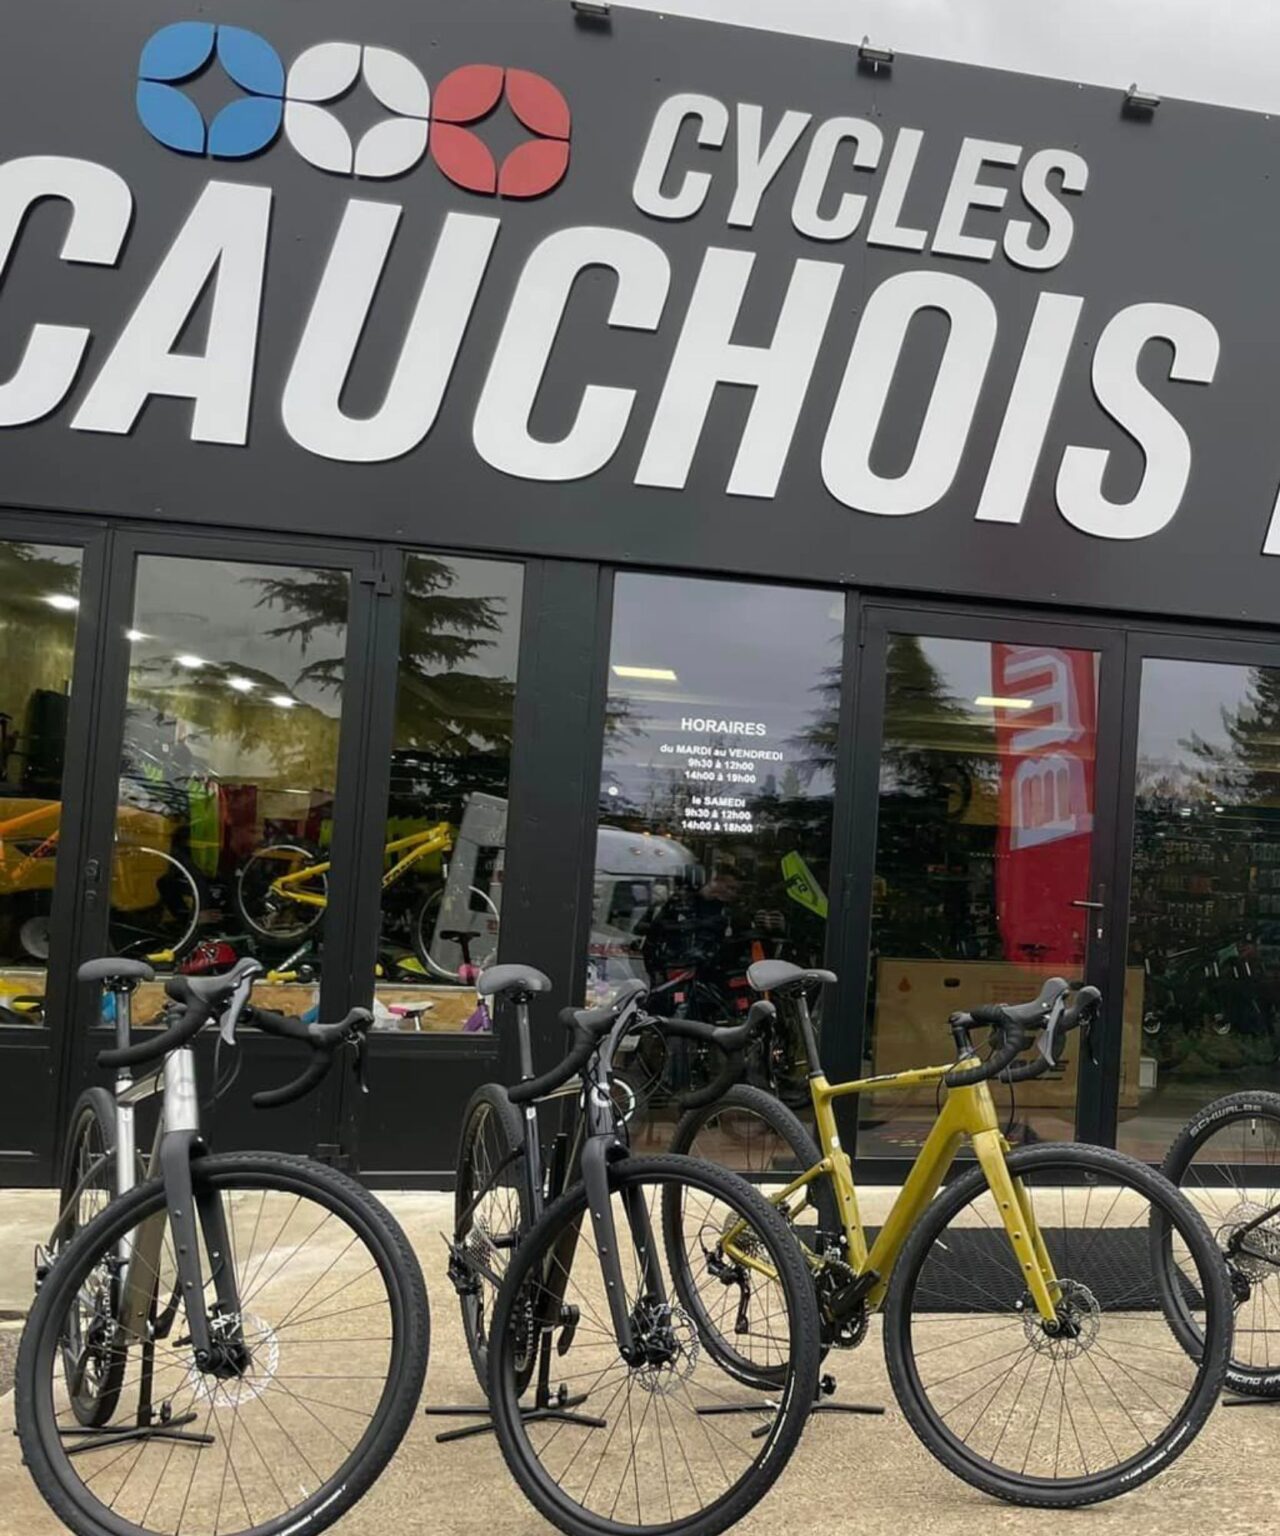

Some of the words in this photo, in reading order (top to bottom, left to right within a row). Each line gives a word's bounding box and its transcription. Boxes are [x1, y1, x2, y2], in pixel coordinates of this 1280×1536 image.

[632, 93, 1089, 270] CYCLES
[0, 155, 1220, 540] CAUCHOIS
[681, 717, 766, 736] HORAIRES
[660, 744, 673, 753] du
[676, 744, 712, 756] MARDI
[713, 747, 726, 757] au
[728, 747, 783, 761] VENDREDI
[688, 757, 713, 768] 9h30
[715, 758, 722, 769] à
[724, 760, 754, 771] 12h00
[685, 770, 715, 781] 14h00
[717, 771, 723, 781] à
[726, 772, 756, 784] 19h00
[692, 795, 701, 804] le
[704, 796, 746, 808] SAMEDI
[685, 808, 710, 818] 9h30
[712, 809, 718, 819] à
[721, 810, 751, 820] 12h00
[681, 820, 712, 831] 14h00
[713, 820, 720, 831] à
[1190, 1103, 1262, 1138] SCHWALBE
